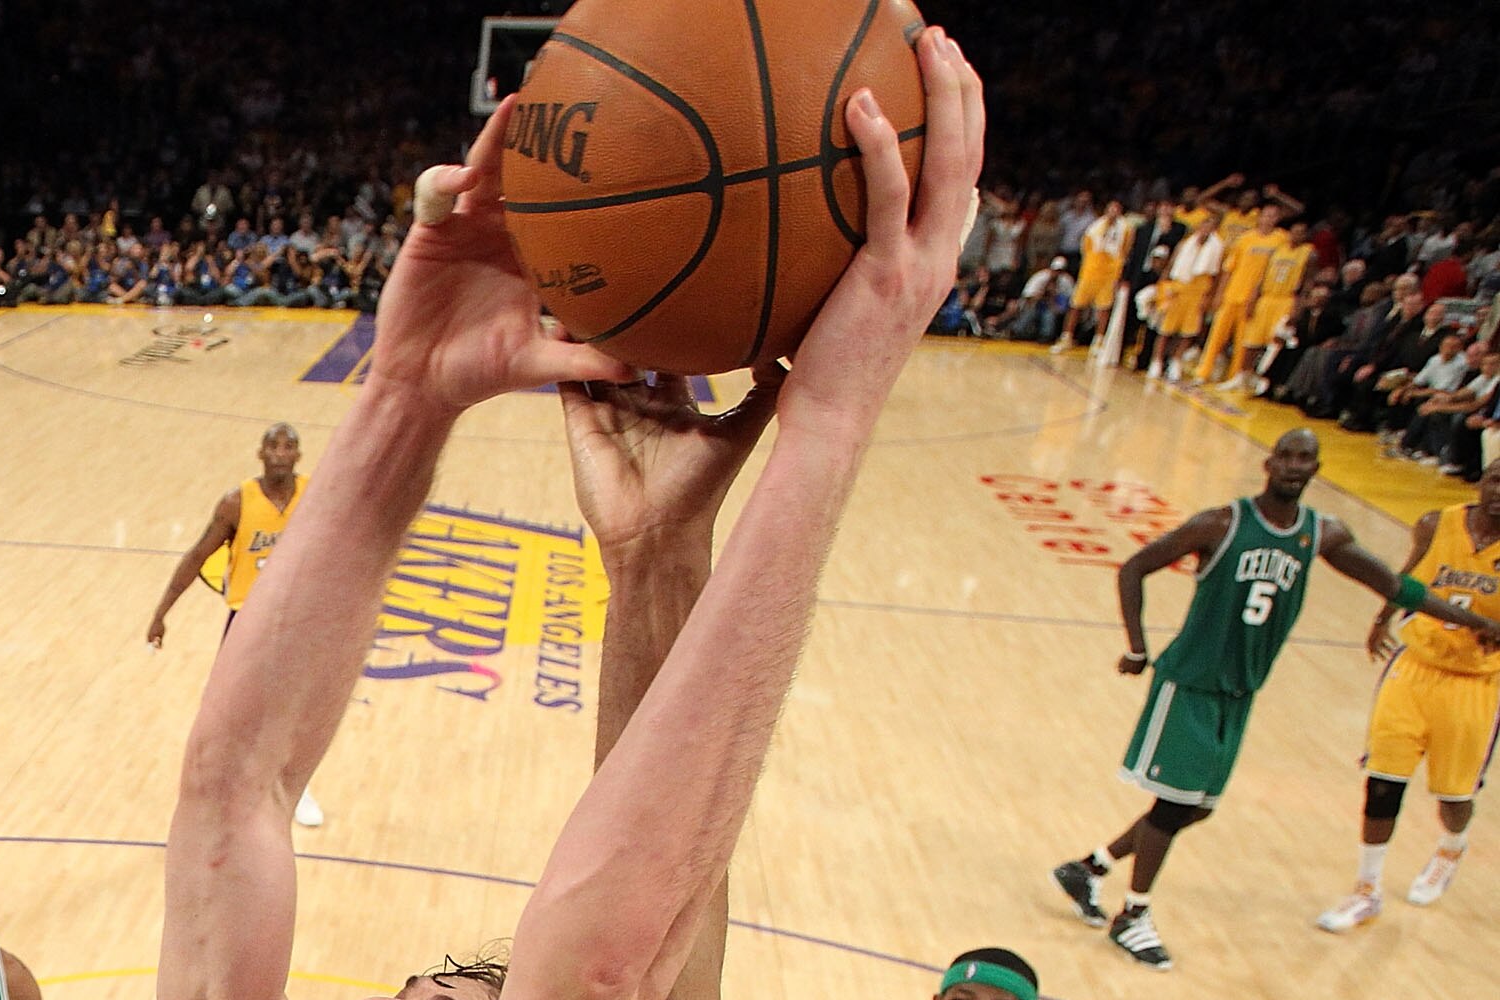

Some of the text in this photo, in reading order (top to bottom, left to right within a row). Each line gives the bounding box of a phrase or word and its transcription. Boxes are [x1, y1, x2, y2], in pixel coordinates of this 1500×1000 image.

[1235, 548, 1301, 592] CELTICS
[1241, 581, 1278, 626] 5
[533, 551, 585, 713] LOS ANGELES
